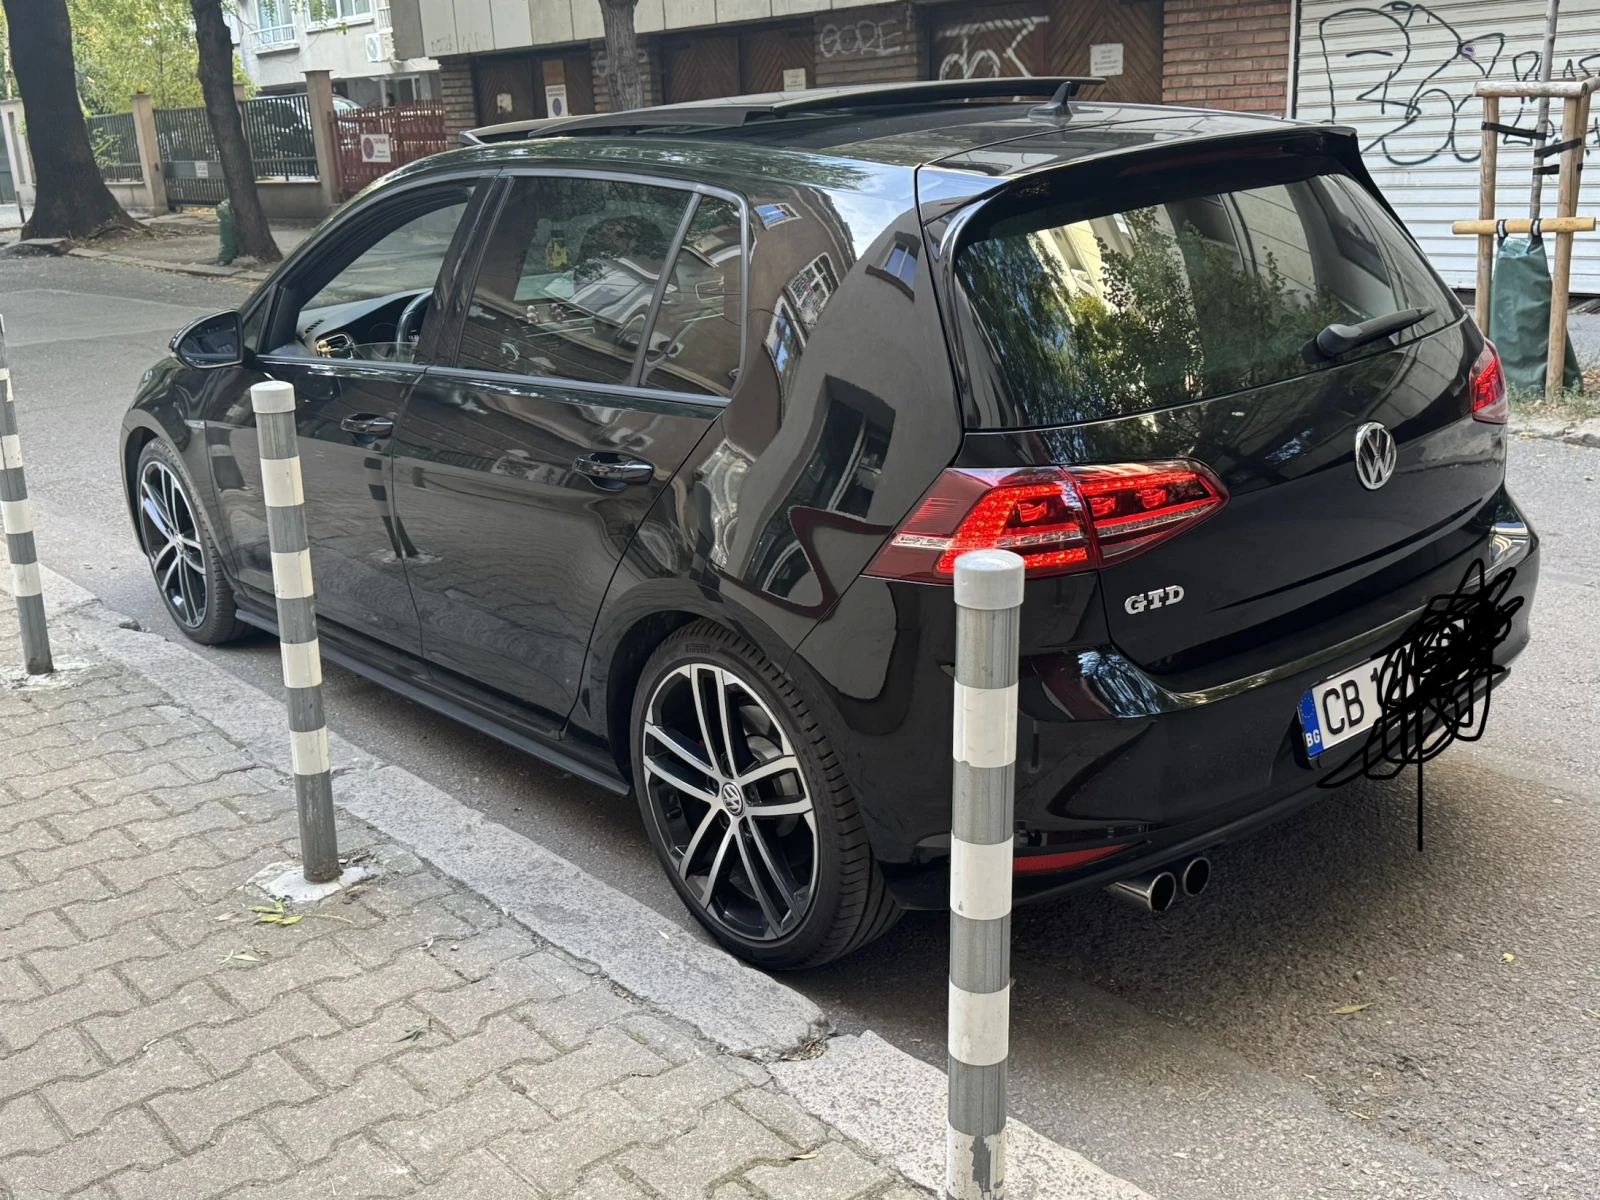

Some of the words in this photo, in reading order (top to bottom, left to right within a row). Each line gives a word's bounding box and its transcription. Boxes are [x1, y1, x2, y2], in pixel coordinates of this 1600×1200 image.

[1355, 421, 1397, 490] VW
[1124, 585, 1185, 615] GTD
[1322, 679, 1365, 736] CB
[1305, 729, 1320, 747] BG
